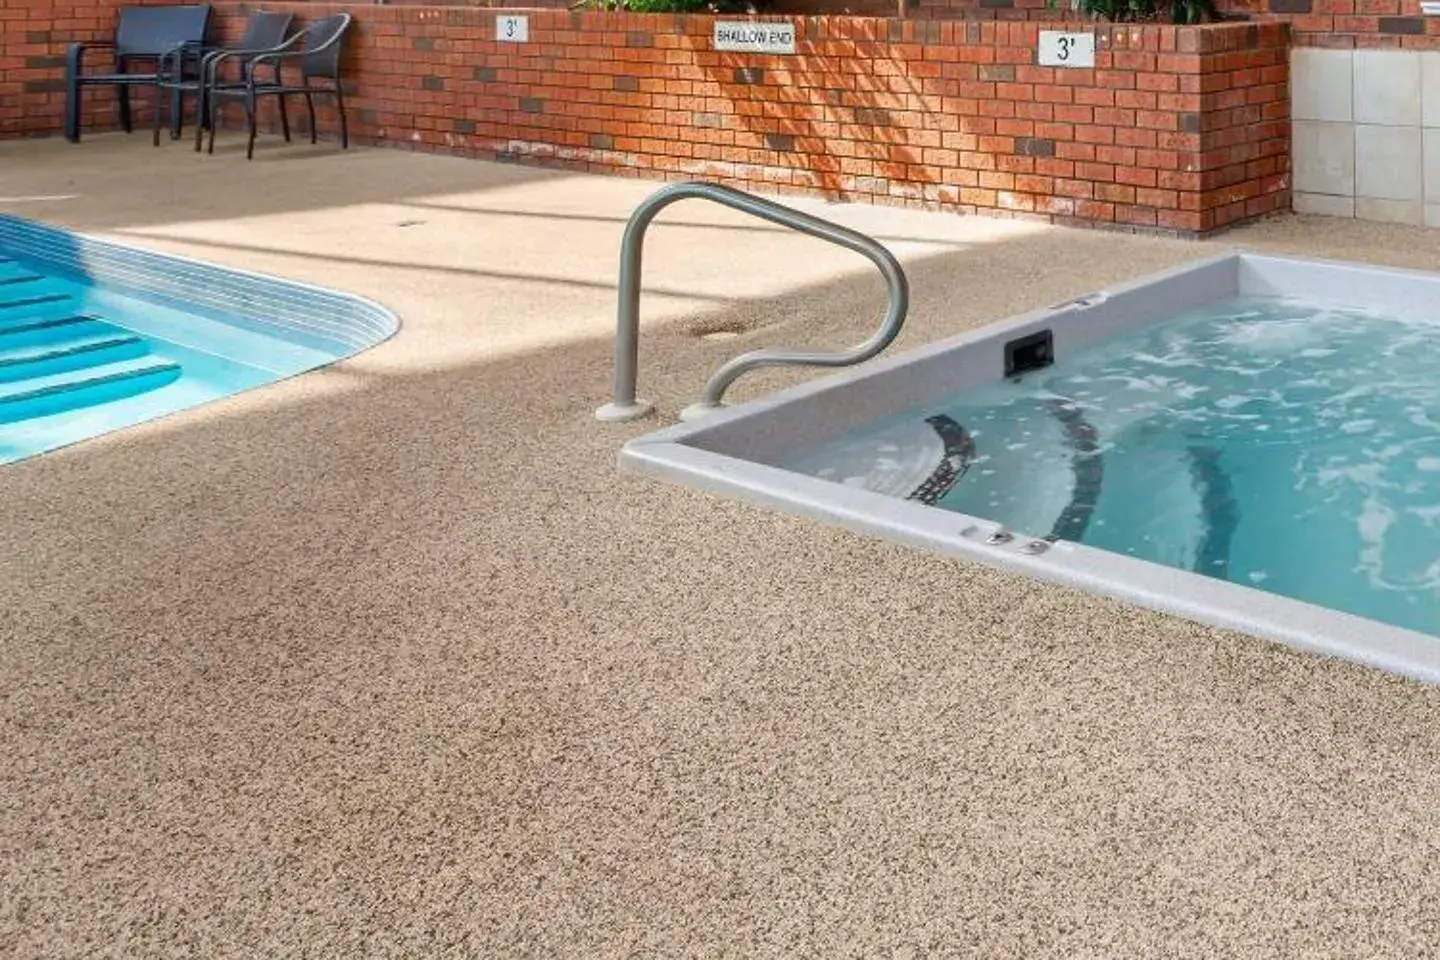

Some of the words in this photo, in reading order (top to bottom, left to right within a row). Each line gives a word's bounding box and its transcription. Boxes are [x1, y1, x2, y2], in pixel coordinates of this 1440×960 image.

[717, 29, 767, 44] SHALLOW
[769, 31, 792, 45] END
[1057, 37, 1075, 60] 3'
